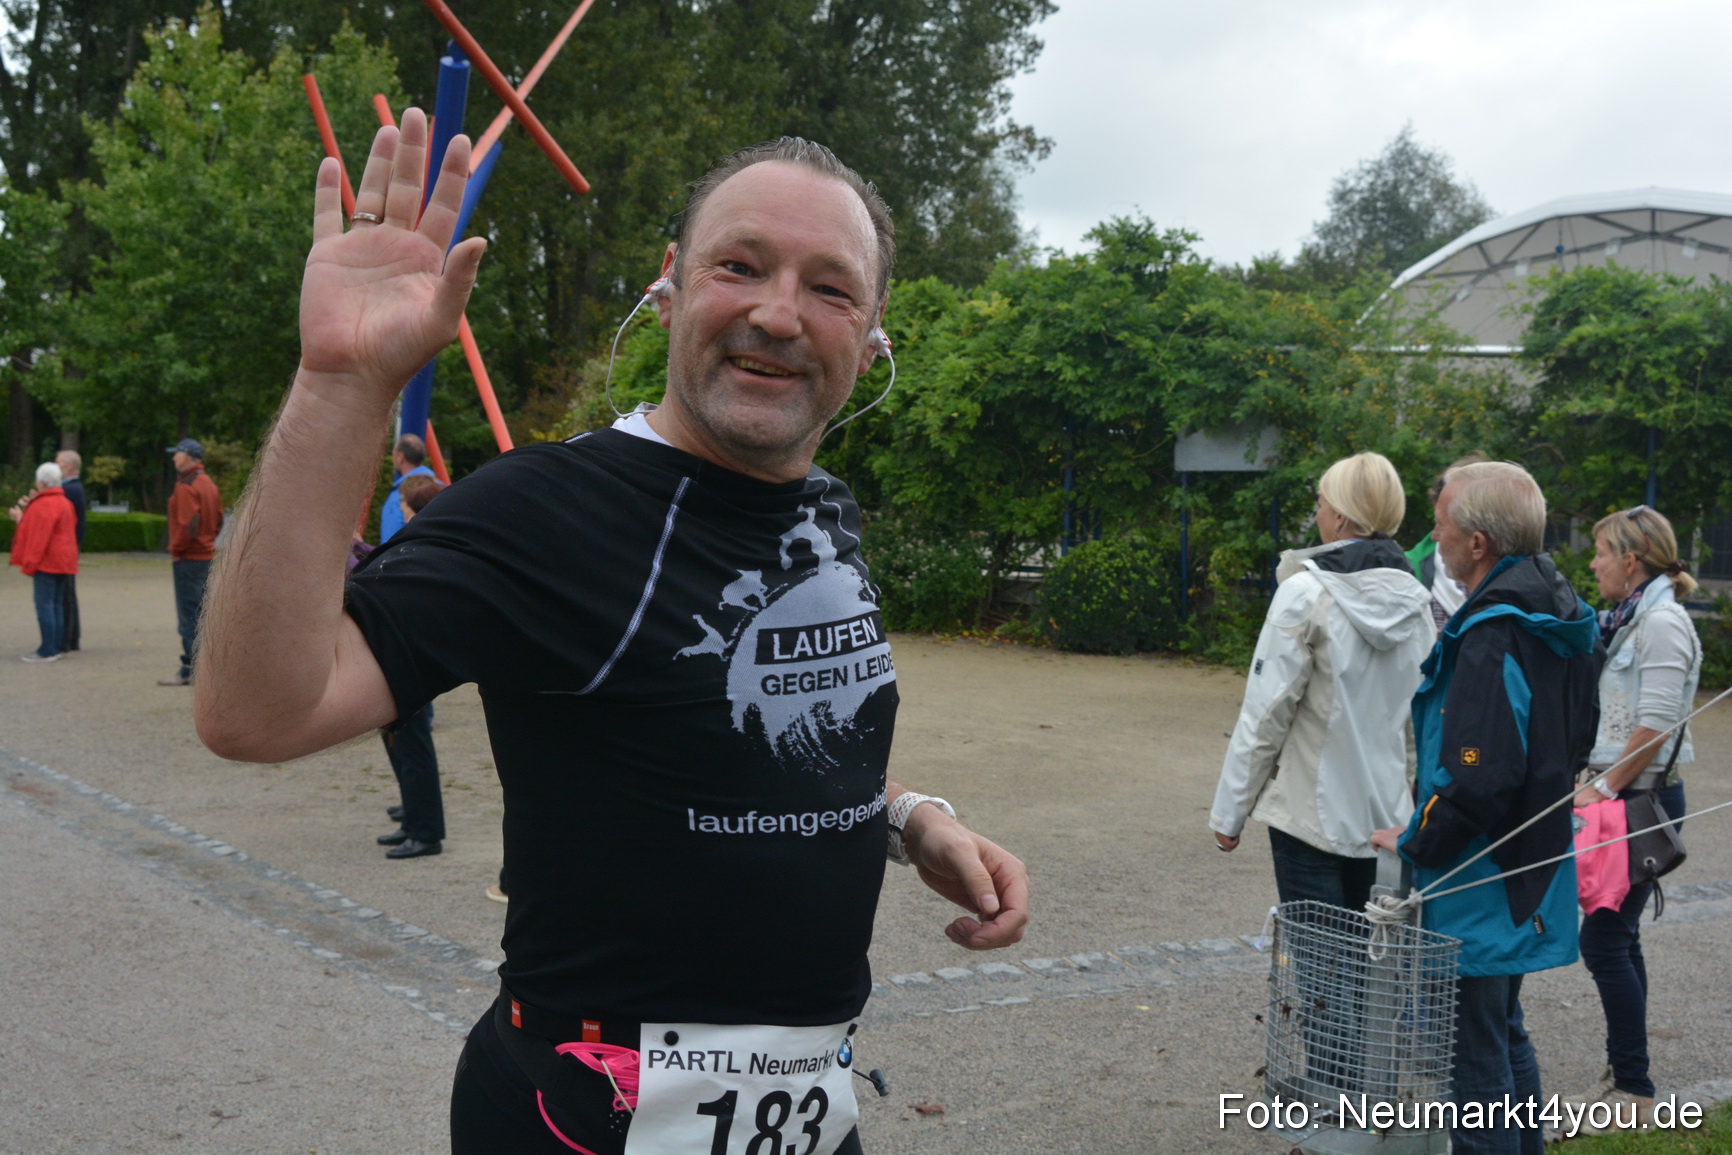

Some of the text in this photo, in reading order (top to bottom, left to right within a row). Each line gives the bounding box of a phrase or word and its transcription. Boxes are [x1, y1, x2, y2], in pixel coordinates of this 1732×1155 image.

[772, 616, 879, 661] LAUFEN
[760, 665, 849, 696] GEGEN
[647, 1049, 835, 1076] PARTL Neumarkt
[696, 1086, 829, 1155] 183
